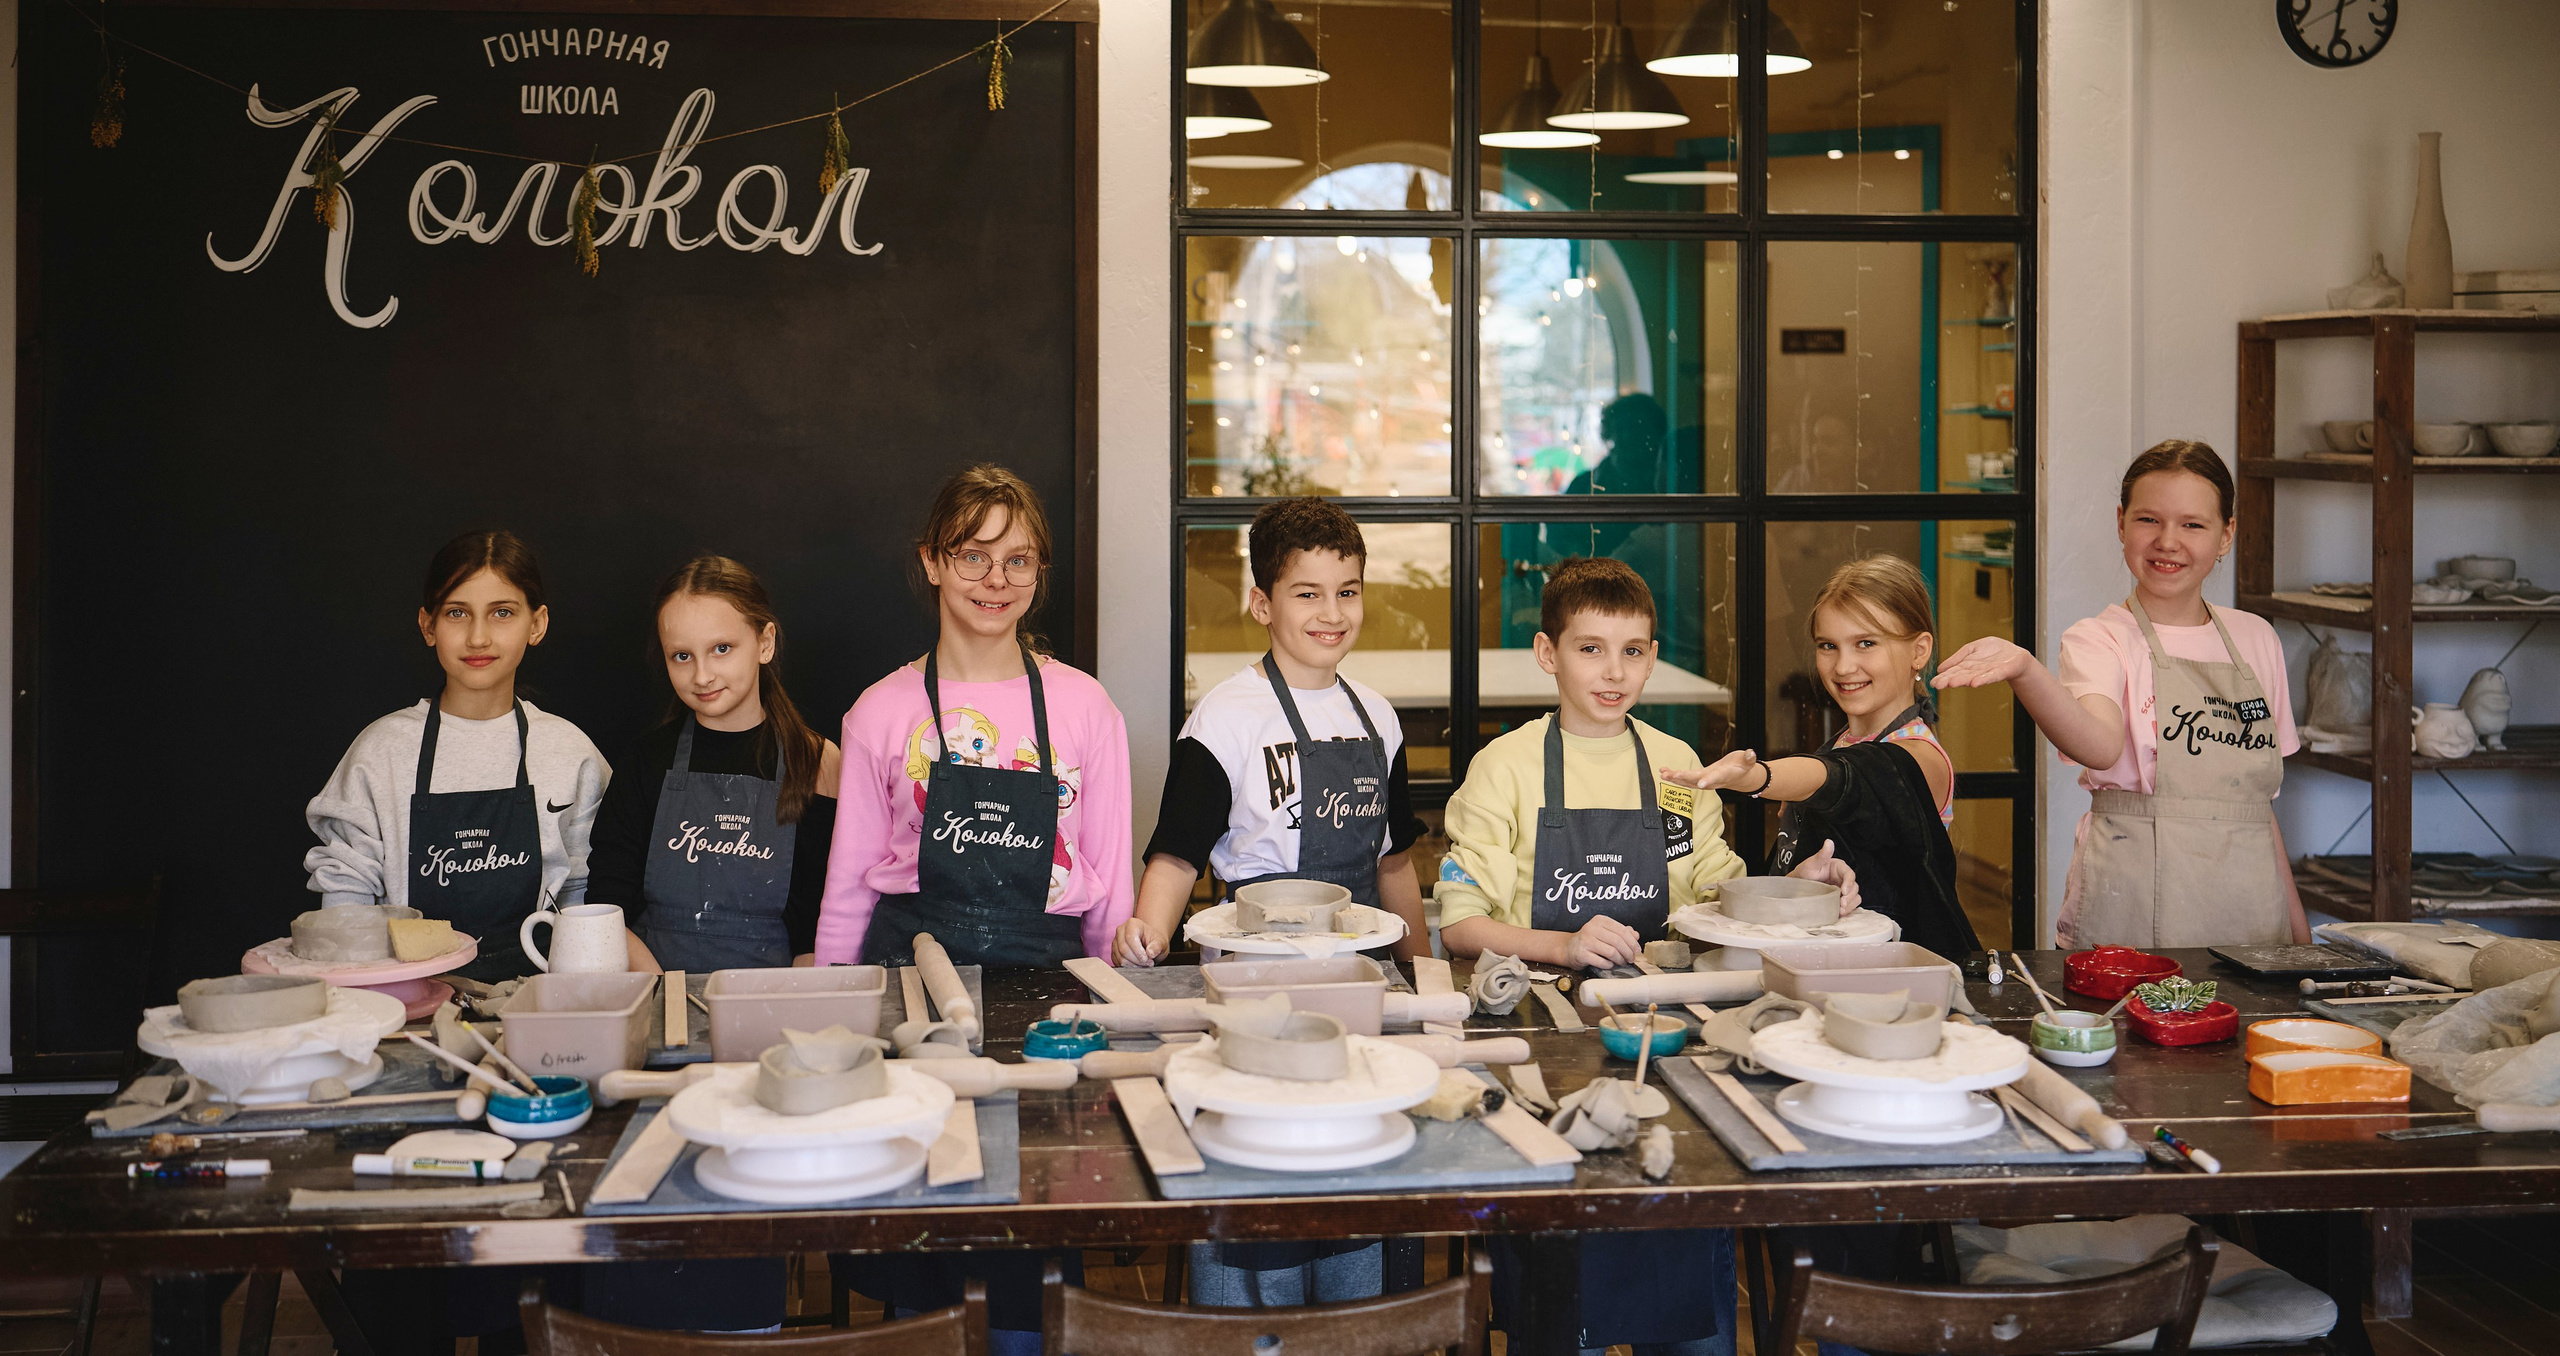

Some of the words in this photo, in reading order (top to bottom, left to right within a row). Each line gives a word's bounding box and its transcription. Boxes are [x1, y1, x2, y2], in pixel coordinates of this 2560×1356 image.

[482, 27, 671, 70] ГОНЧАРНАЯ
[520, 84, 620, 116] ШКОЛА
[205, 82, 884, 330] Колокол
[974, 801, 1011, 813] ГОНЧАРНАЯ
[714, 814, 751, 825] ГОНЧАРНАЯ
[979, 812, 1003, 823] ШКОЛА
[720, 822, 742, 831] ШКОЛА
[932, 810, 1044, 854] Колокол
[455, 828, 491, 840] ГОНЧАРНАЯ
[461, 840, 484, 850] ШКОЛА
[667, 820, 775, 864] Колокол
[1585, 854, 1623, 864] ГОНЧАРНАЯ
[420, 844, 531, 887] Колокол
[1593, 866, 1617, 875] ШКОЛА
[1545, 867, 1660, 914] Колокол
